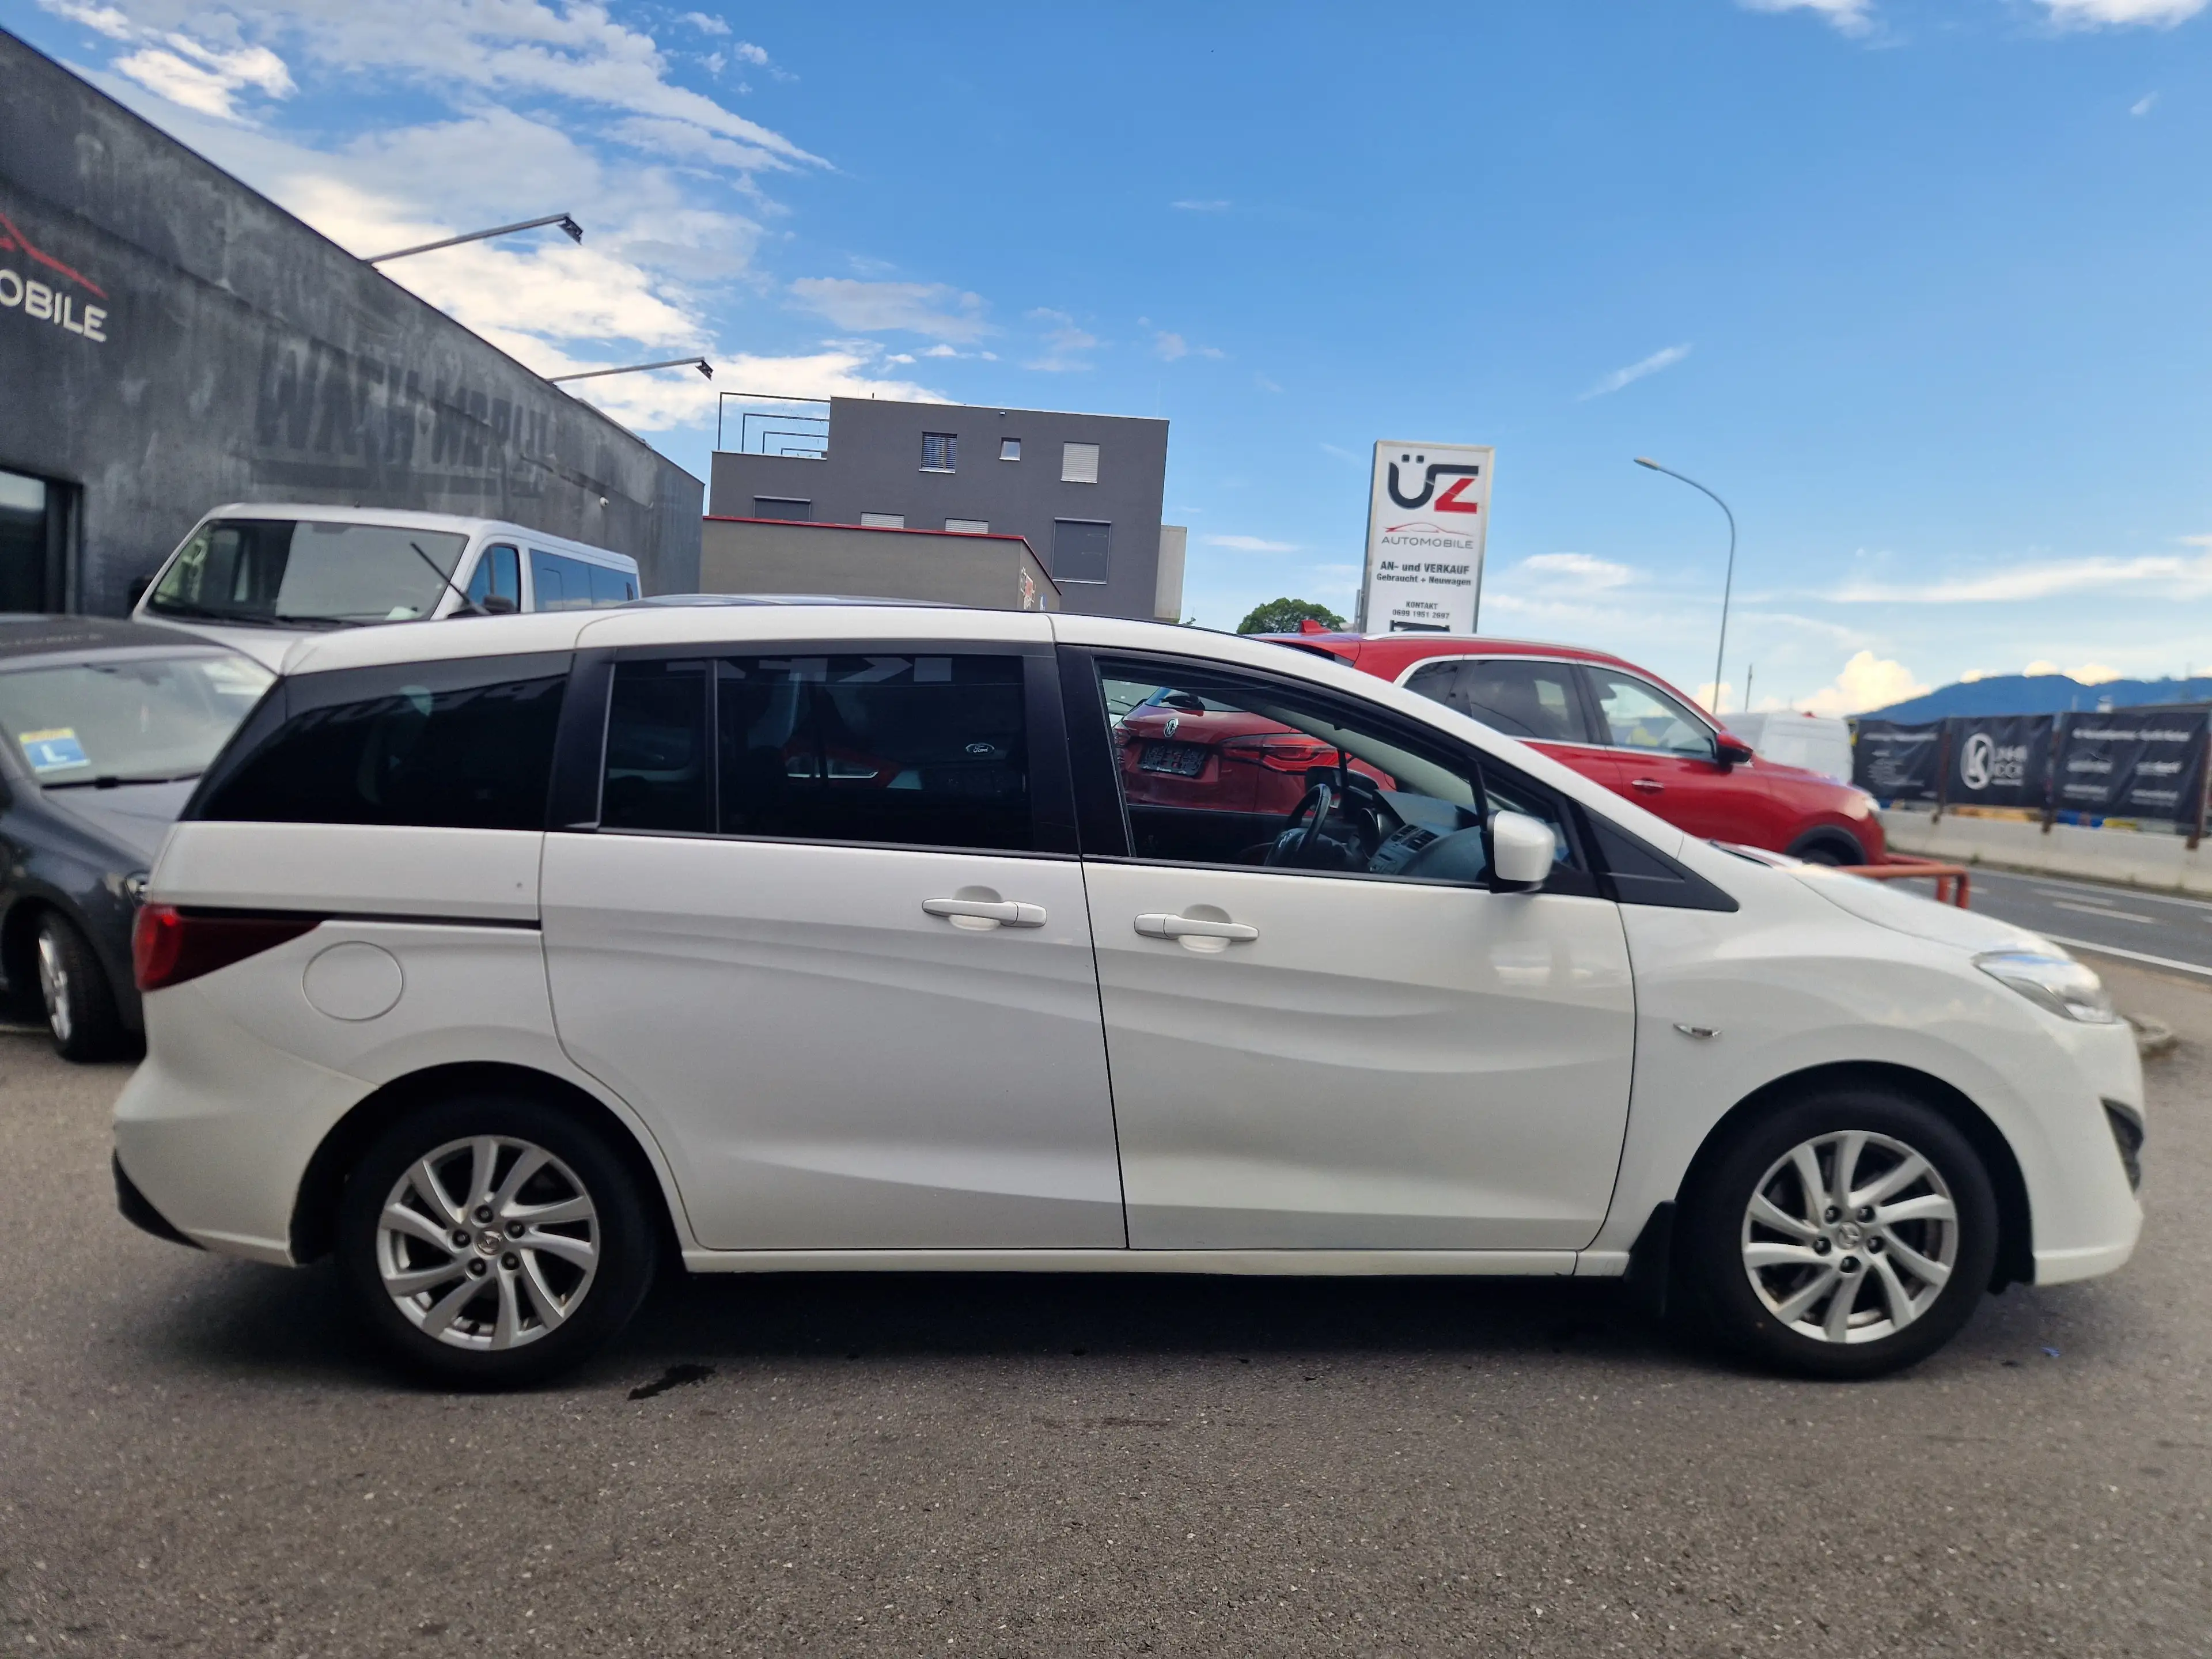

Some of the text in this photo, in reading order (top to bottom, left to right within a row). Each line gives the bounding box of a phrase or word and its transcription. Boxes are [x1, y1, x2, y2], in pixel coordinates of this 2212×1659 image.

[0, 268, 108, 343] OBILE
[1381, 536, 1474, 549] AUTOMOBILE
[1380, 561, 1470, 574] AN- und VERKAUF
[1376, 573, 1418, 583] Gebraucht
[1428, 576, 1471, 586] Neuwagen
[1406, 601, 1438, 609] KONTAKT
[1392, 609, 1410, 617] 0699
[973, 745, 988, 753] Ford
